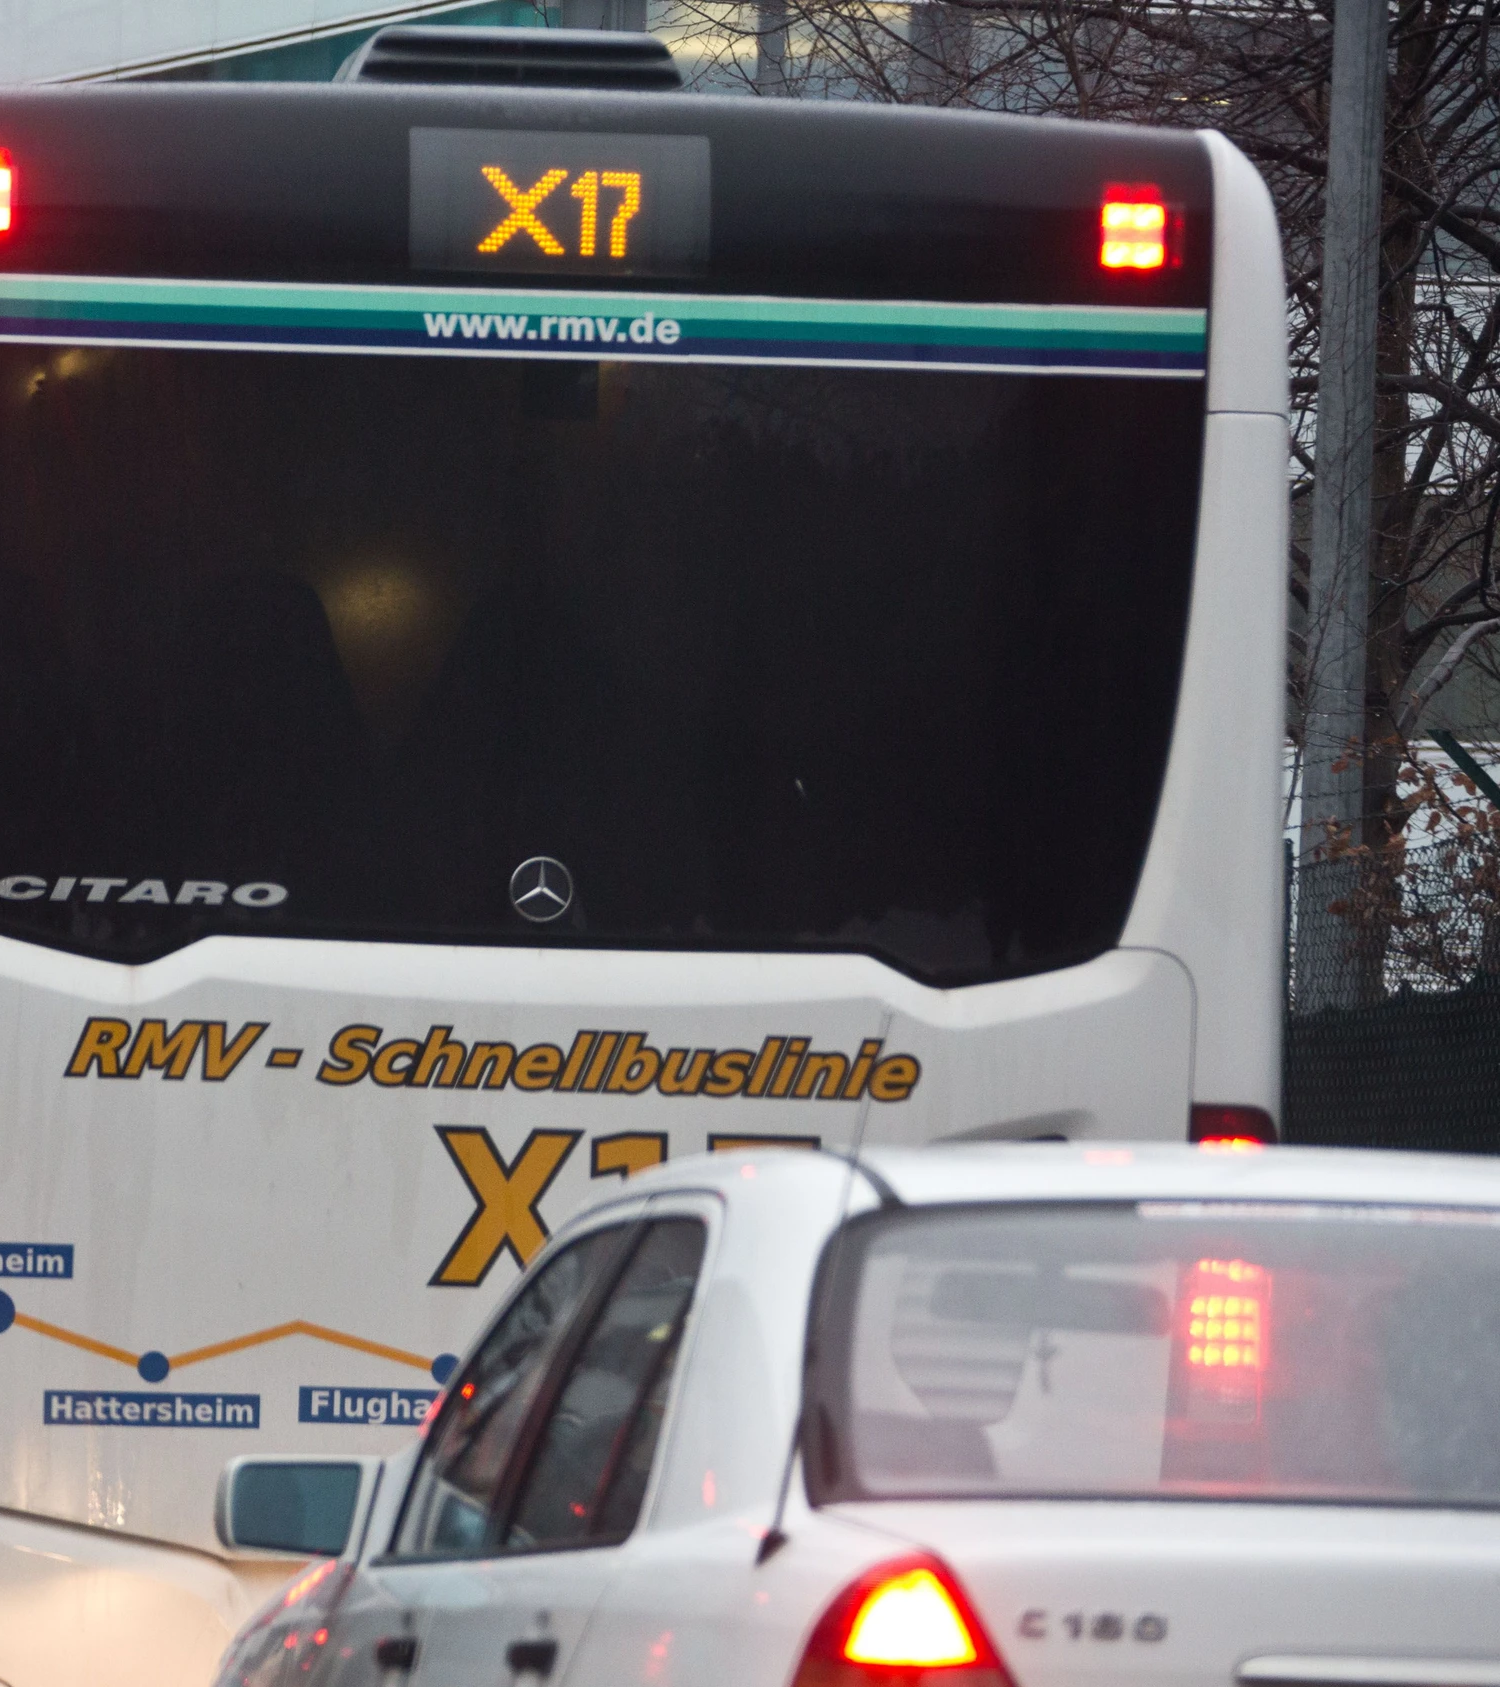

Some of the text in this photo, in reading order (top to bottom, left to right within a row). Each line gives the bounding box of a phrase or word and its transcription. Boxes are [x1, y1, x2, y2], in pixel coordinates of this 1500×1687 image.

[477, 167, 642, 258] X17
[424, 312, 680, 344] www.rmv.de
[64, 1017, 270, 1081] RMV
[316, 1024, 921, 1102] Schnellbuslinie
[51, 1395, 253, 1423] Hattersheim
